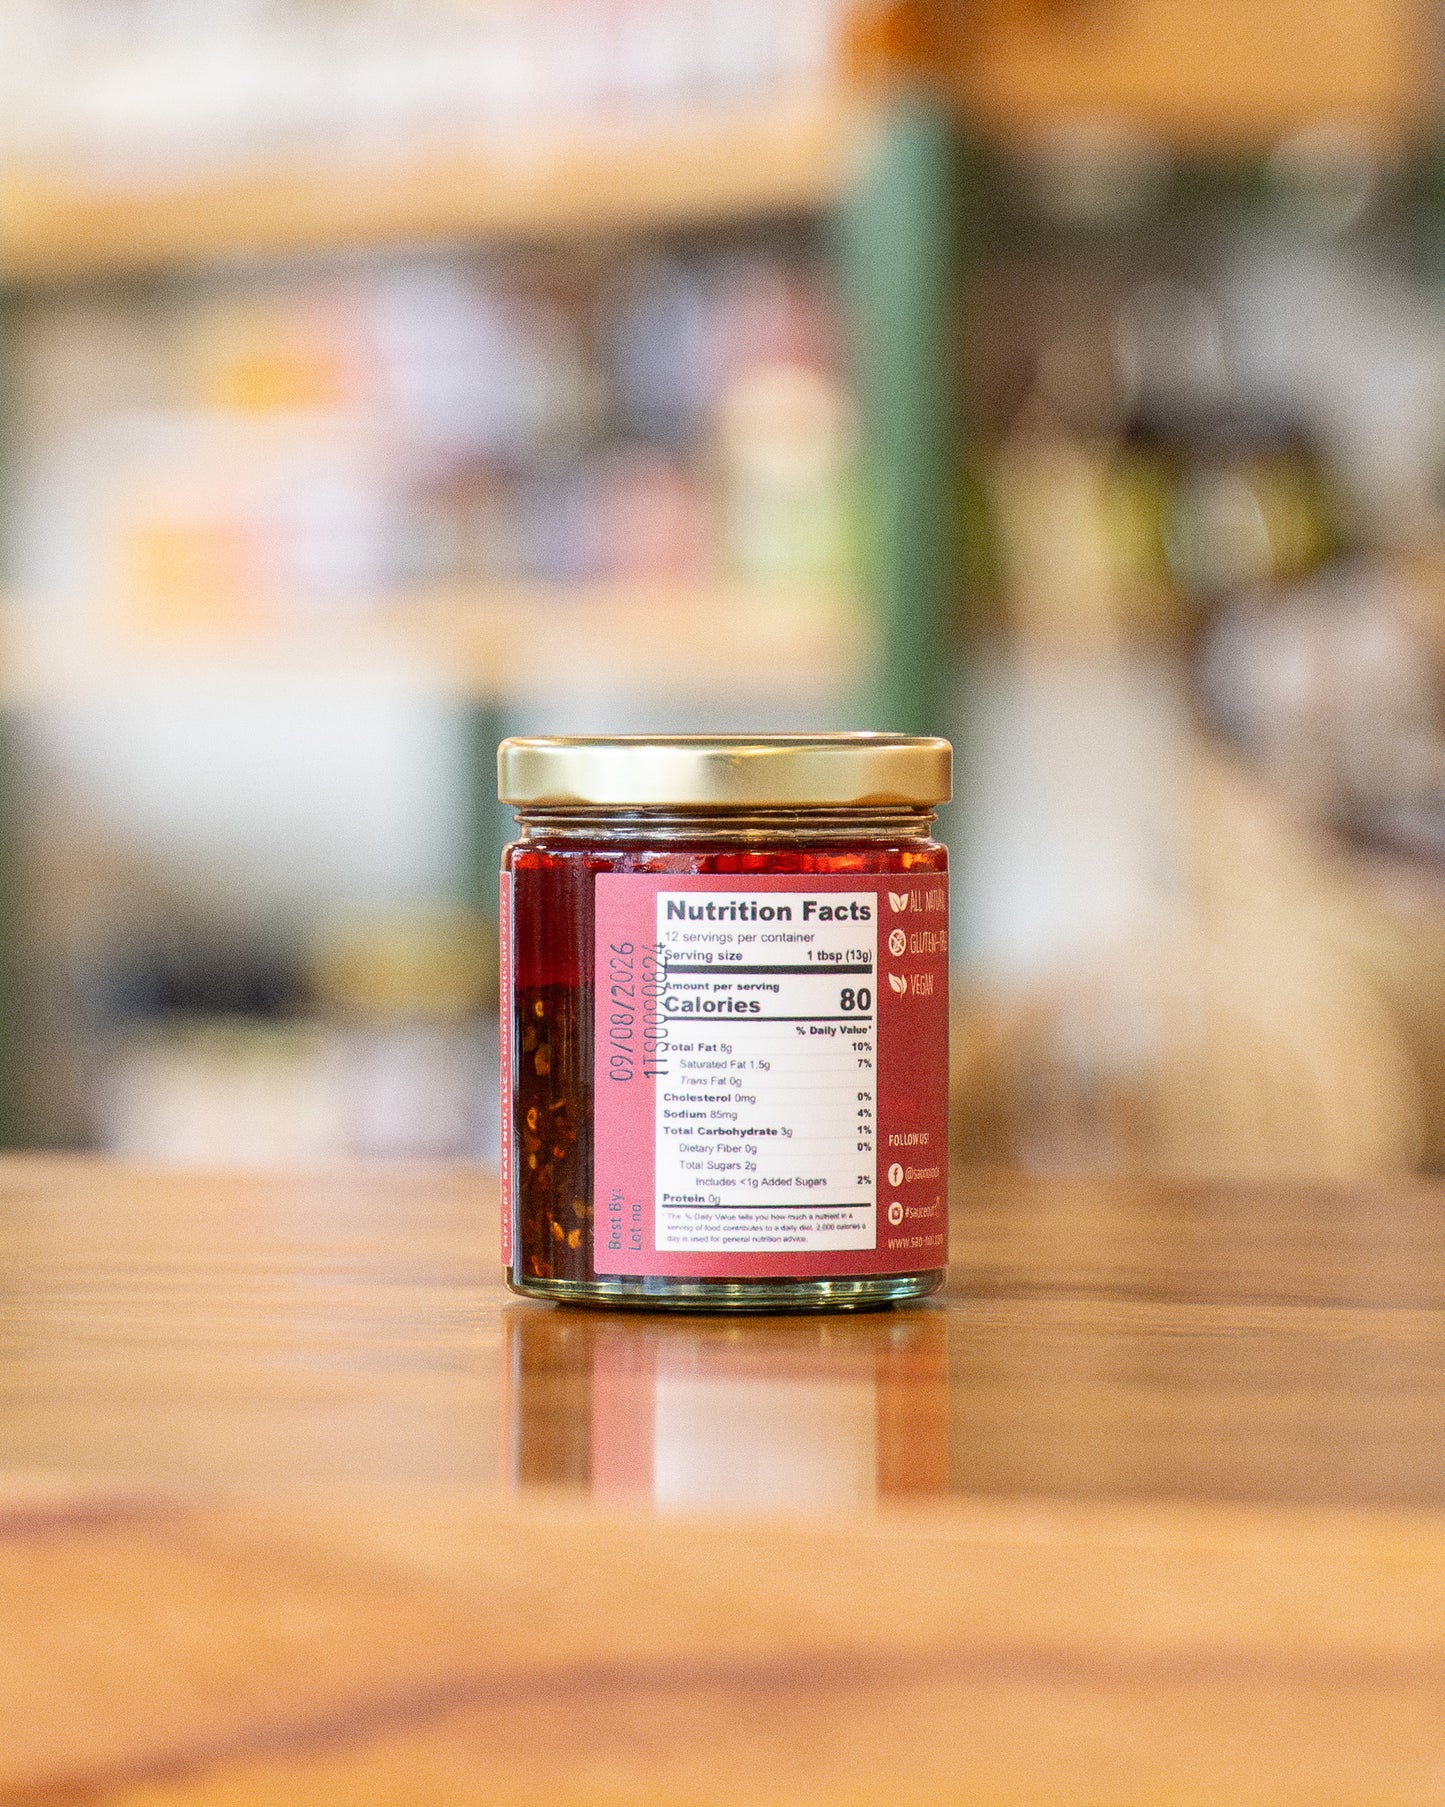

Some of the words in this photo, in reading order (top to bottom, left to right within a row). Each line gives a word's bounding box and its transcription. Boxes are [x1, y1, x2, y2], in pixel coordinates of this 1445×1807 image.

[910, 890, 922, 912] ALL
[667, 900, 792, 921] Nutrition
[803, 900, 872, 921] Facts
[666, 932, 678, 941] 12
[683, 932, 733, 943] servings
[738, 934, 757, 943] per
[761, 932, 814, 942] container
[665, 950, 713, 962] Serving
[718, 950, 743, 960] size
[808, 951, 813, 960] 1
[817, 950, 843, 962] tbsp
[846, 950, 872, 962] (13g)
[666, 982, 709, 991] Amount
[714, 984, 732, 993] per
[737, 983, 780, 993] serving
[910, 974, 934, 995] VEGAN
[665, 997, 761, 1013] Calories
[840, 988, 872, 1011] 80
[610, 942, 634, 1082] 09/08/2026
[796, 1027, 806, 1035] %
[810, 1026, 836, 1037] Daily
[665, 1043, 694, 1052] Total
[698, 1043, 717, 1052] Fat
[720, 1044, 733, 1054] 8g
[852, 1042, 872, 1052] 10%
[680, 1060, 727, 1069] Saturated
[730, 1060, 746, 1069] Fat
[750, 1060, 770, 1071] 1.5g
[857, 1059, 872, 1069] 7%
[681, 1076, 707, 1085] Trans
[710, 1077, 726, 1086] Fat
[730, 1078, 742, 1088] 0g
[663, 1093, 731, 1102] Cholesterol
[734, 1094, 756, 1104] 0mg
[857, 1092, 872, 1101] 0%
[663, 1110, 707, 1119] Sodium
[710, 1111, 738, 1121] 85mg
[857, 1109, 872, 1118] 4%
[664, 1127, 693, 1136] Total
[697, 1127, 778, 1138] Carbohydrate
[780, 1128, 793, 1138] 3g
[857, 1125, 872, 1135] 1%
[889, 1133, 918, 1147] FOLLOW
[679, 1144, 714, 1155] Dietary
[717, 1144, 742, 1153] Fiber
[745, 1145, 757, 1155] 0g
[857, 1142, 872, 1152] 0%
[680, 1161, 704, 1170] Total
[707, 1161, 741, 1172] Sugars
[744, 1162, 757, 1172] 2g
[696, 1178, 736, 1186] Includes
[739, 1178, 759, 1189] <1g
[762, 1178, 792, 1186] Added
[795, 1178, 827, 1188] Sugars
[857, 1176, 872, 1185] 2%
[608, 1188, 625, 1212] By:
[663, 1194, 705, 1203] Protein
[708, 1195, 721, 1205] 0g
[608, 1218, 622, 1250] Best
[628, 1227, 642, 1251] Lot
[722, 1235, 750, 1243] general
